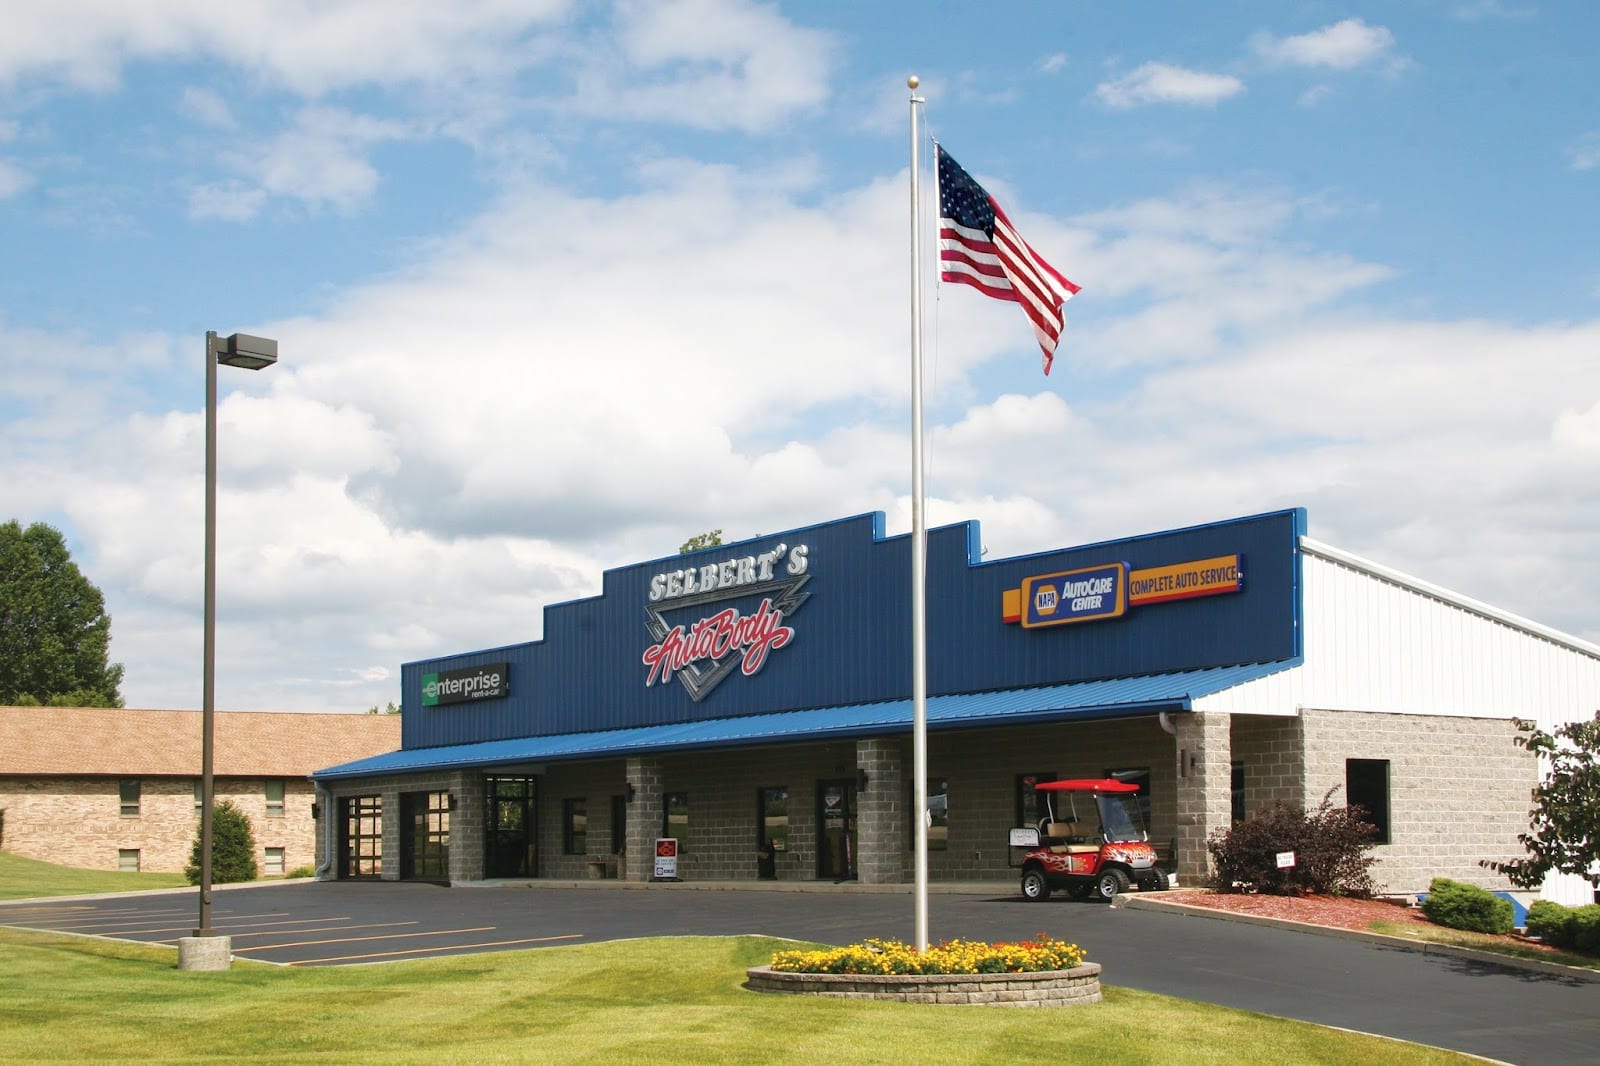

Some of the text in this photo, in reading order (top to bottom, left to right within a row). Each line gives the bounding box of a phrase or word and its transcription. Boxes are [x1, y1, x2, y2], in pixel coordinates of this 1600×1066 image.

[649, 543, 809, 601] SELBERT'S
[1130, 566, 1236, 595] COMPLETE AUTO SERVICE
[1038, 591, 1056, 609] NAPA
[1071, 595, 1102, 612] CENTER
[422, 671, 500, 698] enterprise
[471, 689, 499, 698] rent-a-car
